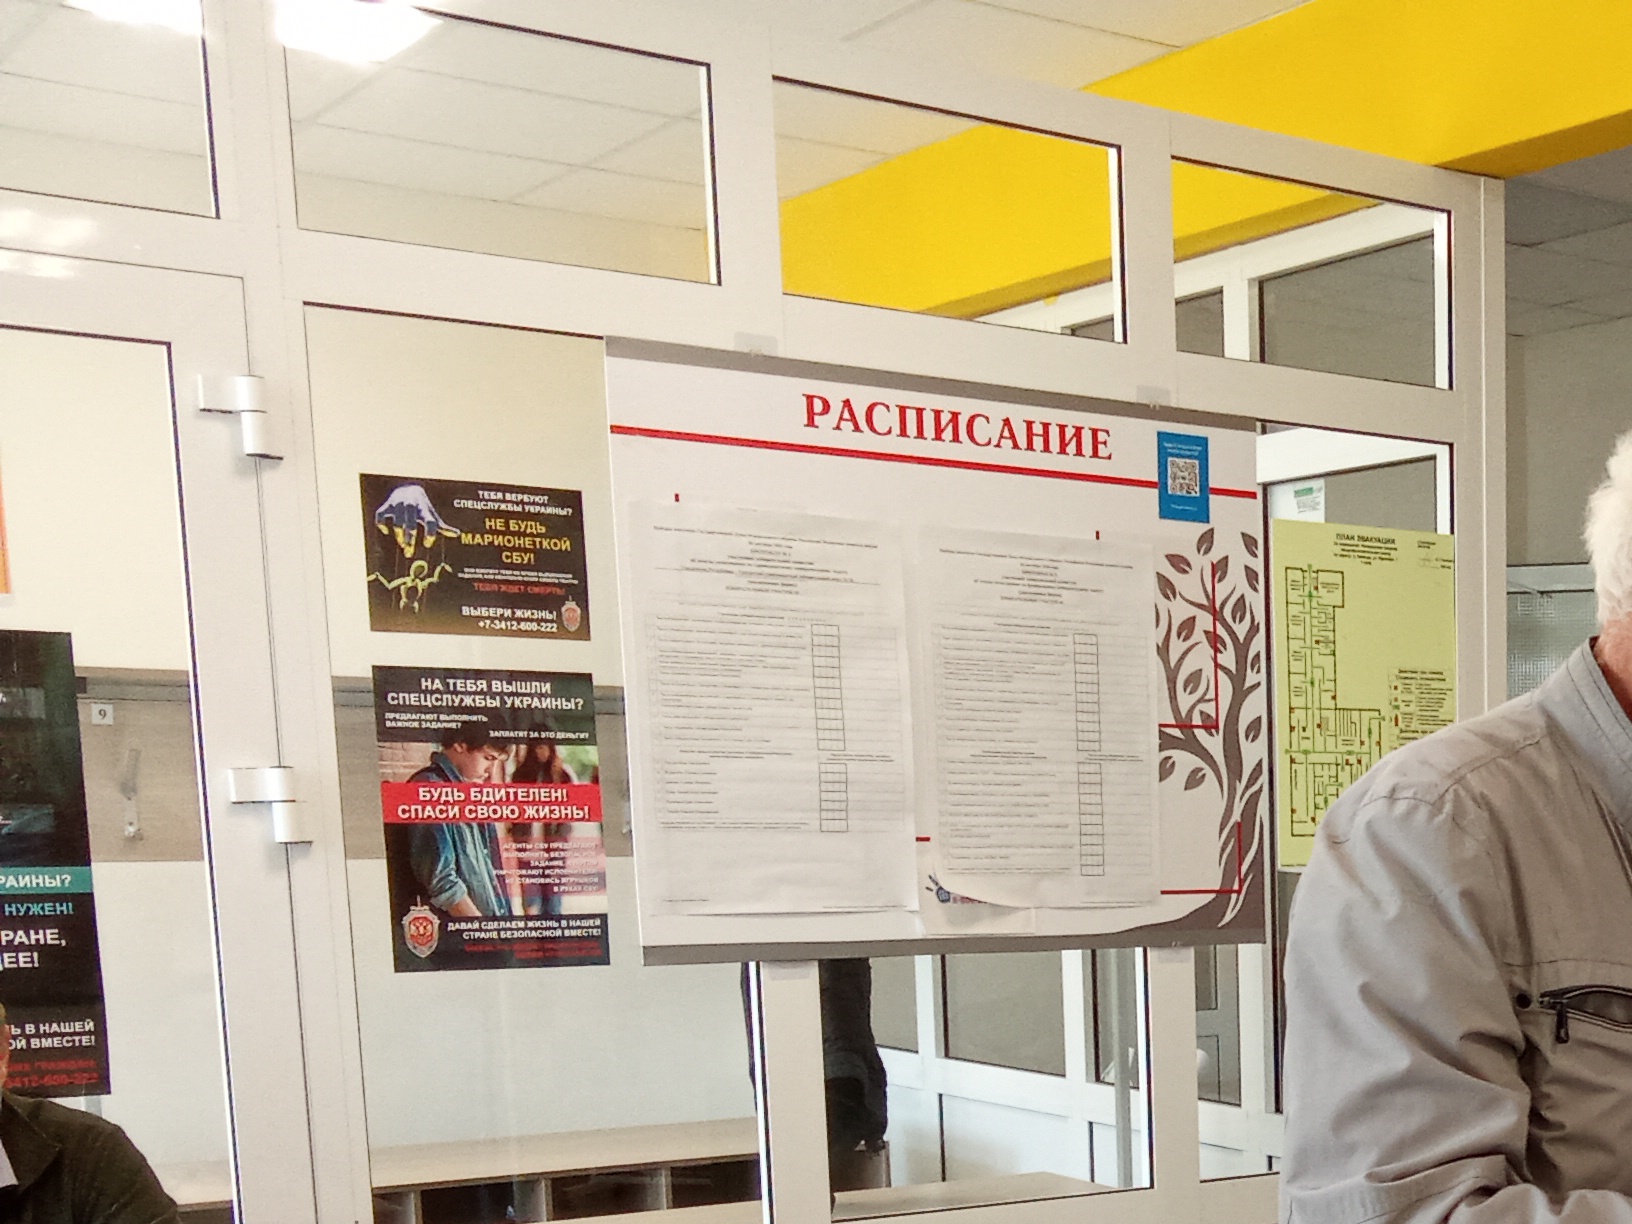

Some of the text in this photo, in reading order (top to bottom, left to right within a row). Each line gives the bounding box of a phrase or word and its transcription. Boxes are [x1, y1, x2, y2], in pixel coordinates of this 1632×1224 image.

[802, 393, 1113, 461] РАСПИСАНИЕ
[478, 490, 548, 504] ТЕБЯ ВЕРБУЮТ
[453, 499, 572, 516] СПЕЦСЛУЖБЫ УКРАИНЫ?
[485, 518, 546, 534] НЕ БУДЬ
[460, 532, 571, 552] МАРИОНЕТКОЙ
[502, 552, 535, 565] СБУ!
[461, 606, 512, 618] ВЫБЕРИ
[421, 677, 551, 695] НА ТЕБЯ ВЫШЛИ
[387, 693, 584, 710] СПЕЦСЛУЖБЫ УКРАИНЫ?
[98, 708, 107, 721] 9
[541, 731, 555, 739] ЭТО
[418, 787, 568, 804] БУДЬ БДИТЕЛЕН!
[398, 805, 590, 820] СПАСИ СВОЮ ЖИЗНЬ!
[4, 902, 74, 916] НУЖЕН!
[527, 919, 558, 929] ЖИЗНЬ
[561, 920, 567, 928] В
[0, 928, 66, 946] РАНЕ,
[500, 928, 562, 939] БЕЗОПАСНОЙ
[25, 1023, 36, 1034] В
[39, 1018, 95, 1034] НАШЕЙ
[30, 1035, 96, 1049] ВМЕСТЕ!
